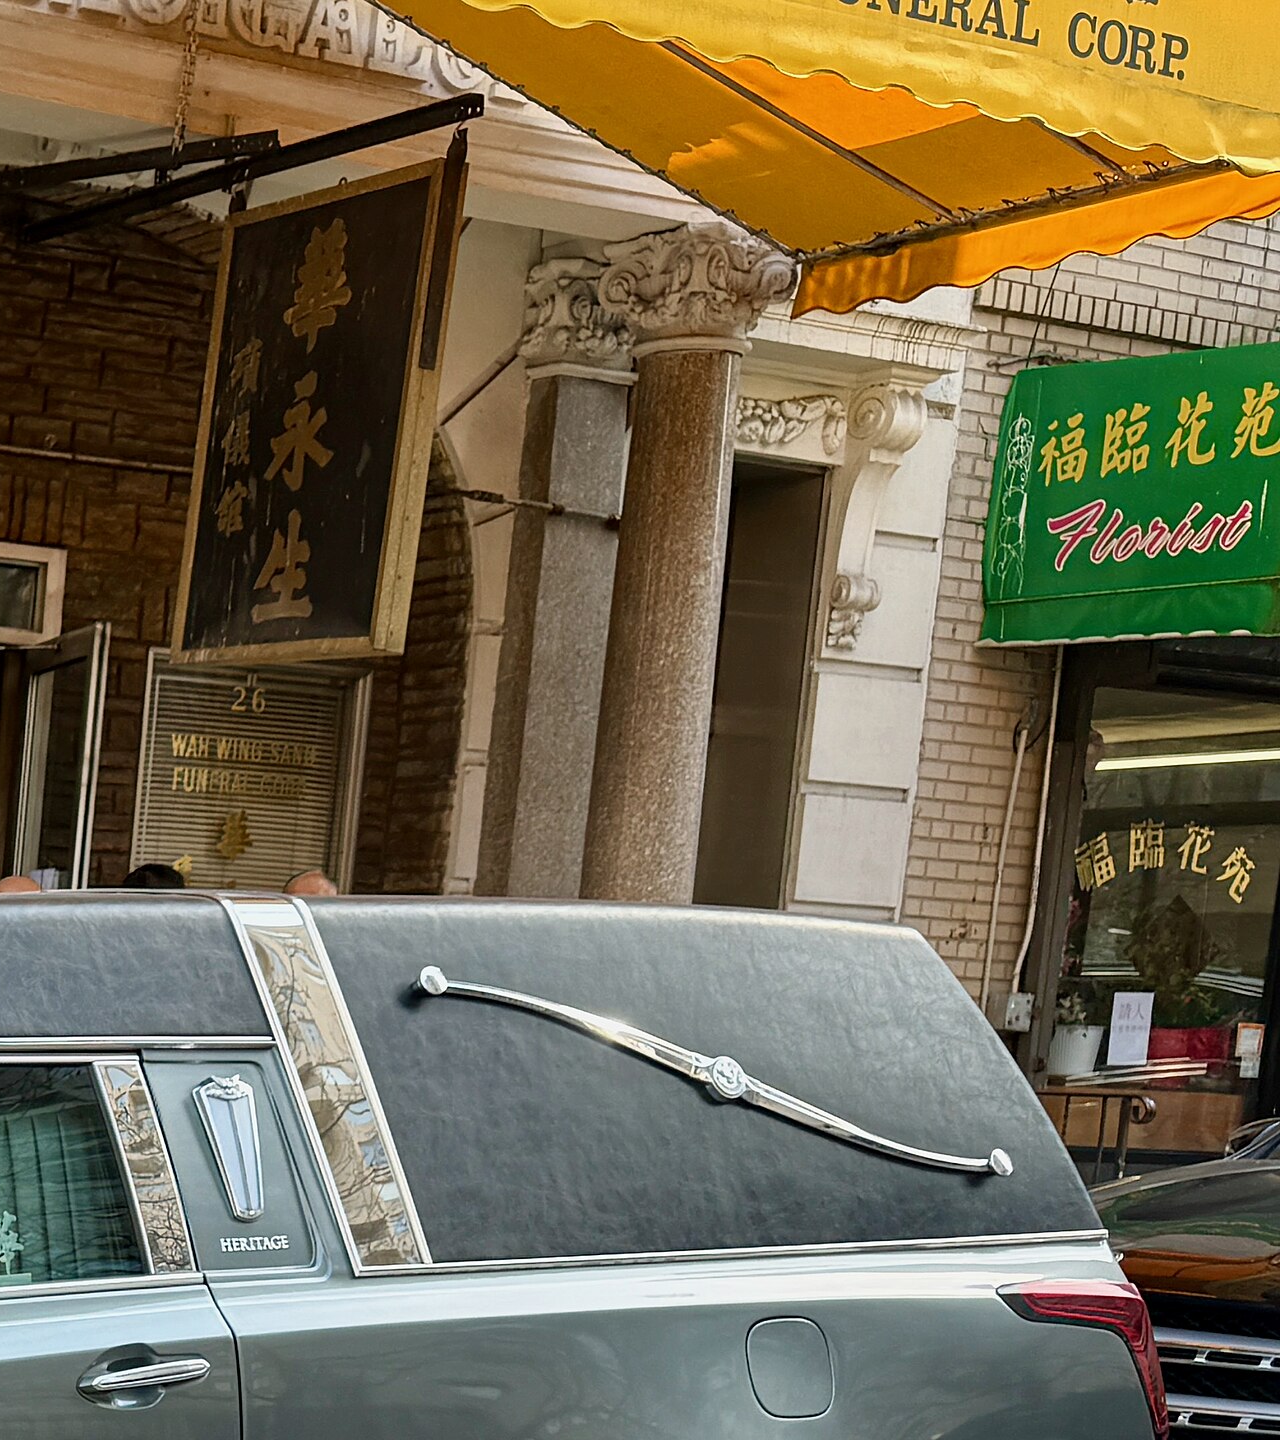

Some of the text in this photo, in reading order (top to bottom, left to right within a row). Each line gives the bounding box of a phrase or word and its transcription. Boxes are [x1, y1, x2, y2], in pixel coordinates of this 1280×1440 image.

[1068, 11, 1190, 80] CORP.
[250, 217, 352, 623] 華永生
[1037, 381, 1280, 488] 福臨花苑
[1046, 498, 1255, 572] Florist
[230, 686, 266, 714] 26
[171, 733, 210, 758] WAH
[216, 737, 264, 762] WING
[171, 765, 250, 795] FUNERAL
[1073, 818, 1257, 905] 福臨花苑
[219, 1235, 290, 1252] HERITAGE
